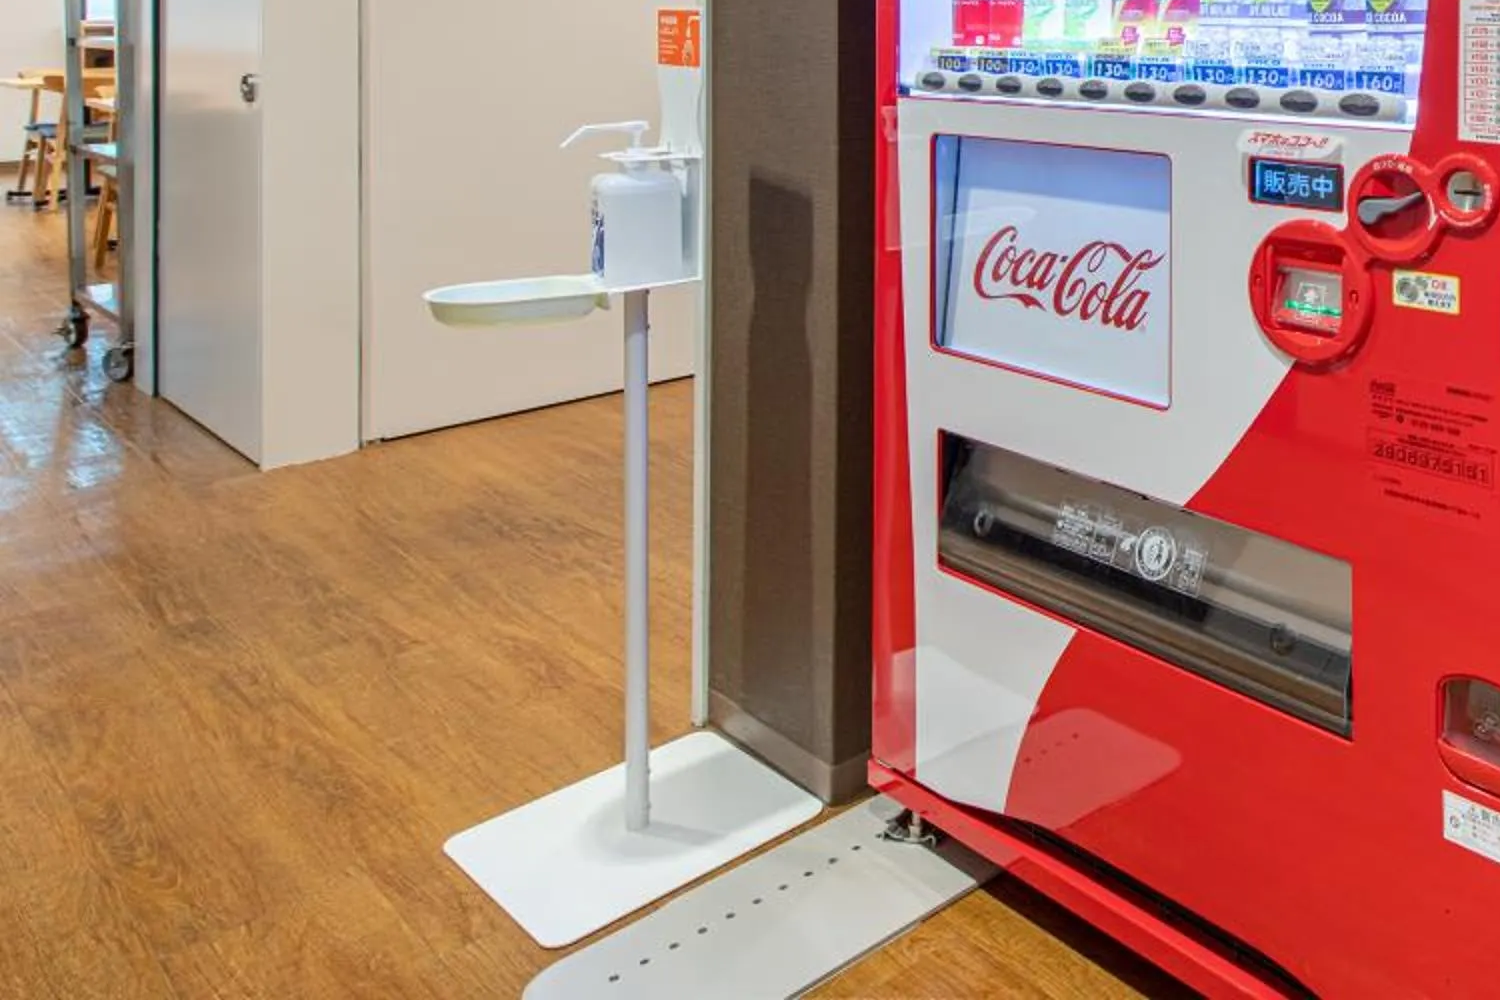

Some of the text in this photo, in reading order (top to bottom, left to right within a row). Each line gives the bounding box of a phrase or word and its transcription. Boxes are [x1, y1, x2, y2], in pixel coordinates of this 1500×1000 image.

[1263, 169, 1333, 200] 販売中
[973, 225, 1167, 331] Coca-Cola
